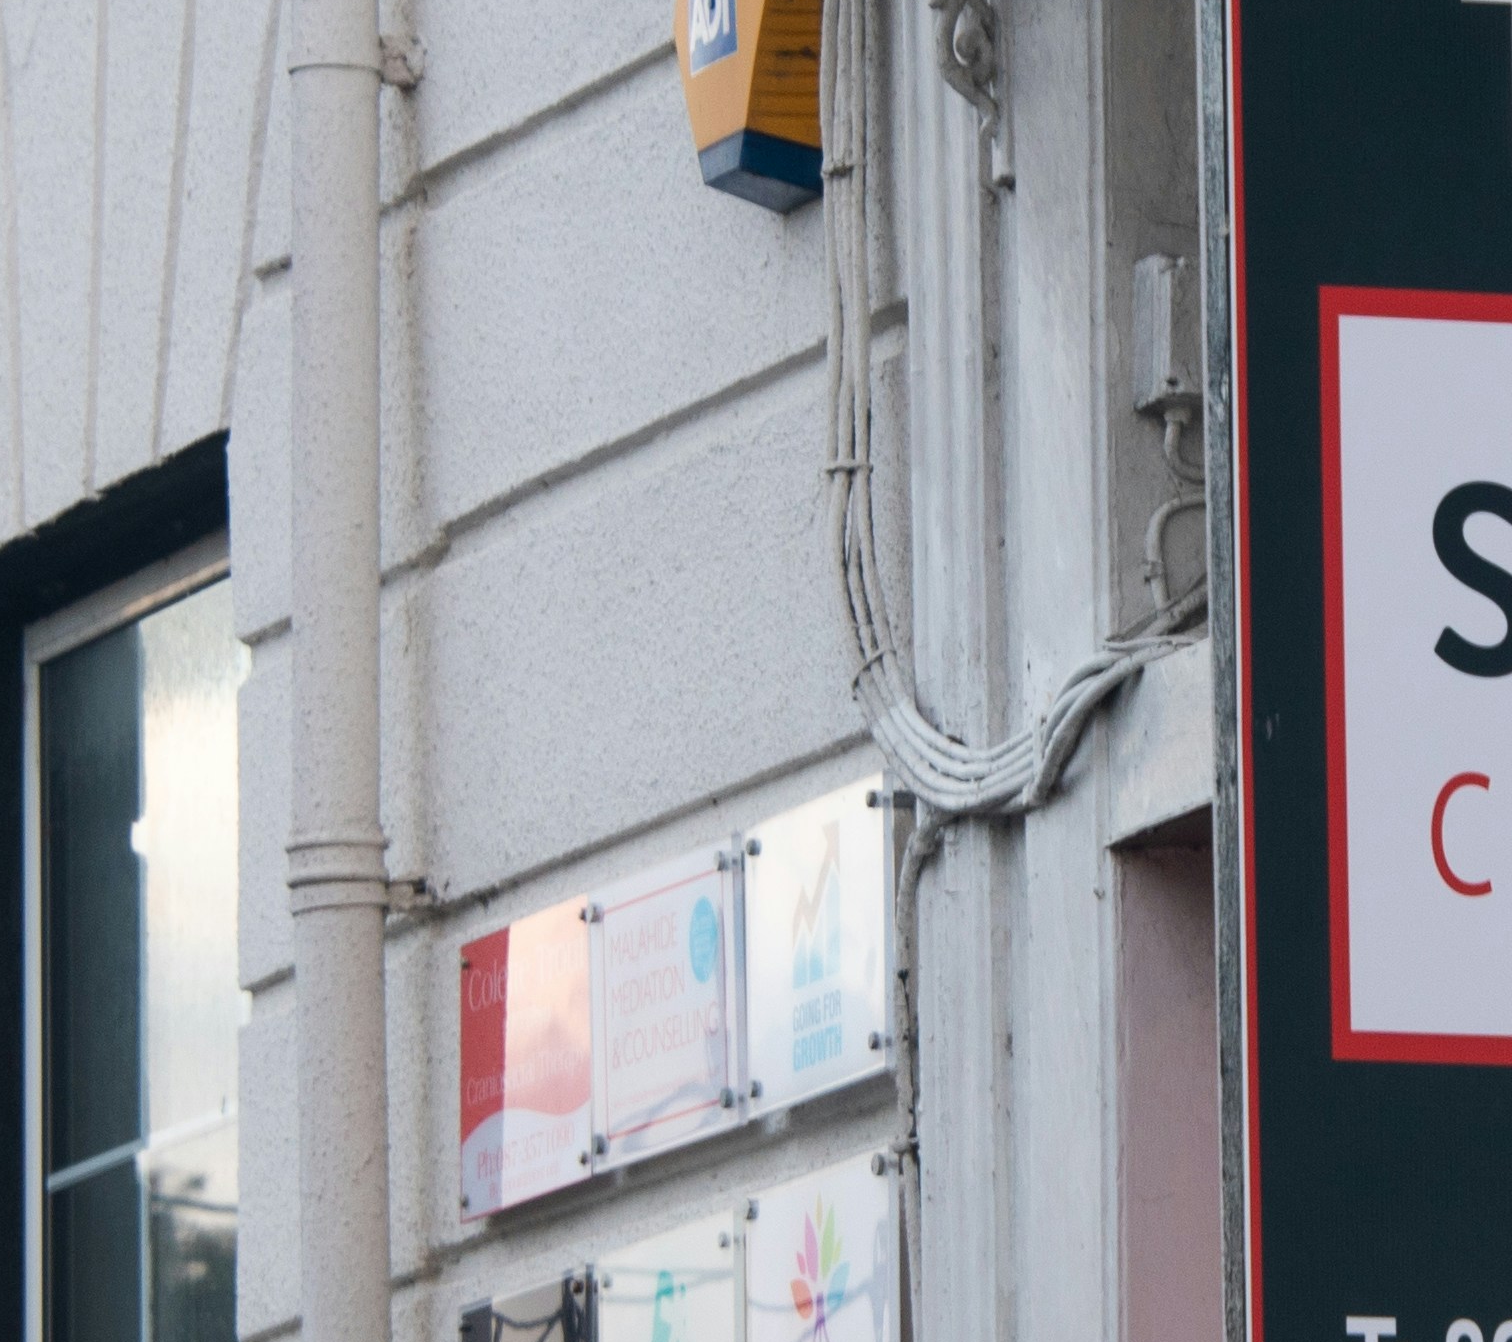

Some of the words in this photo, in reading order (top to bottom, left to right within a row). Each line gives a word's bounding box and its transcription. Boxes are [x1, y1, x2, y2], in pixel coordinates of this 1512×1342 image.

[610, 911, 678, 967] MALAHIDE
[611, 962, 685, 1019] MEDIATION
[793, 996, 821, 1032] GOING
[823, 988, 842, 1021] FOR
[793, 1023, 843, 1073] GROWTH
